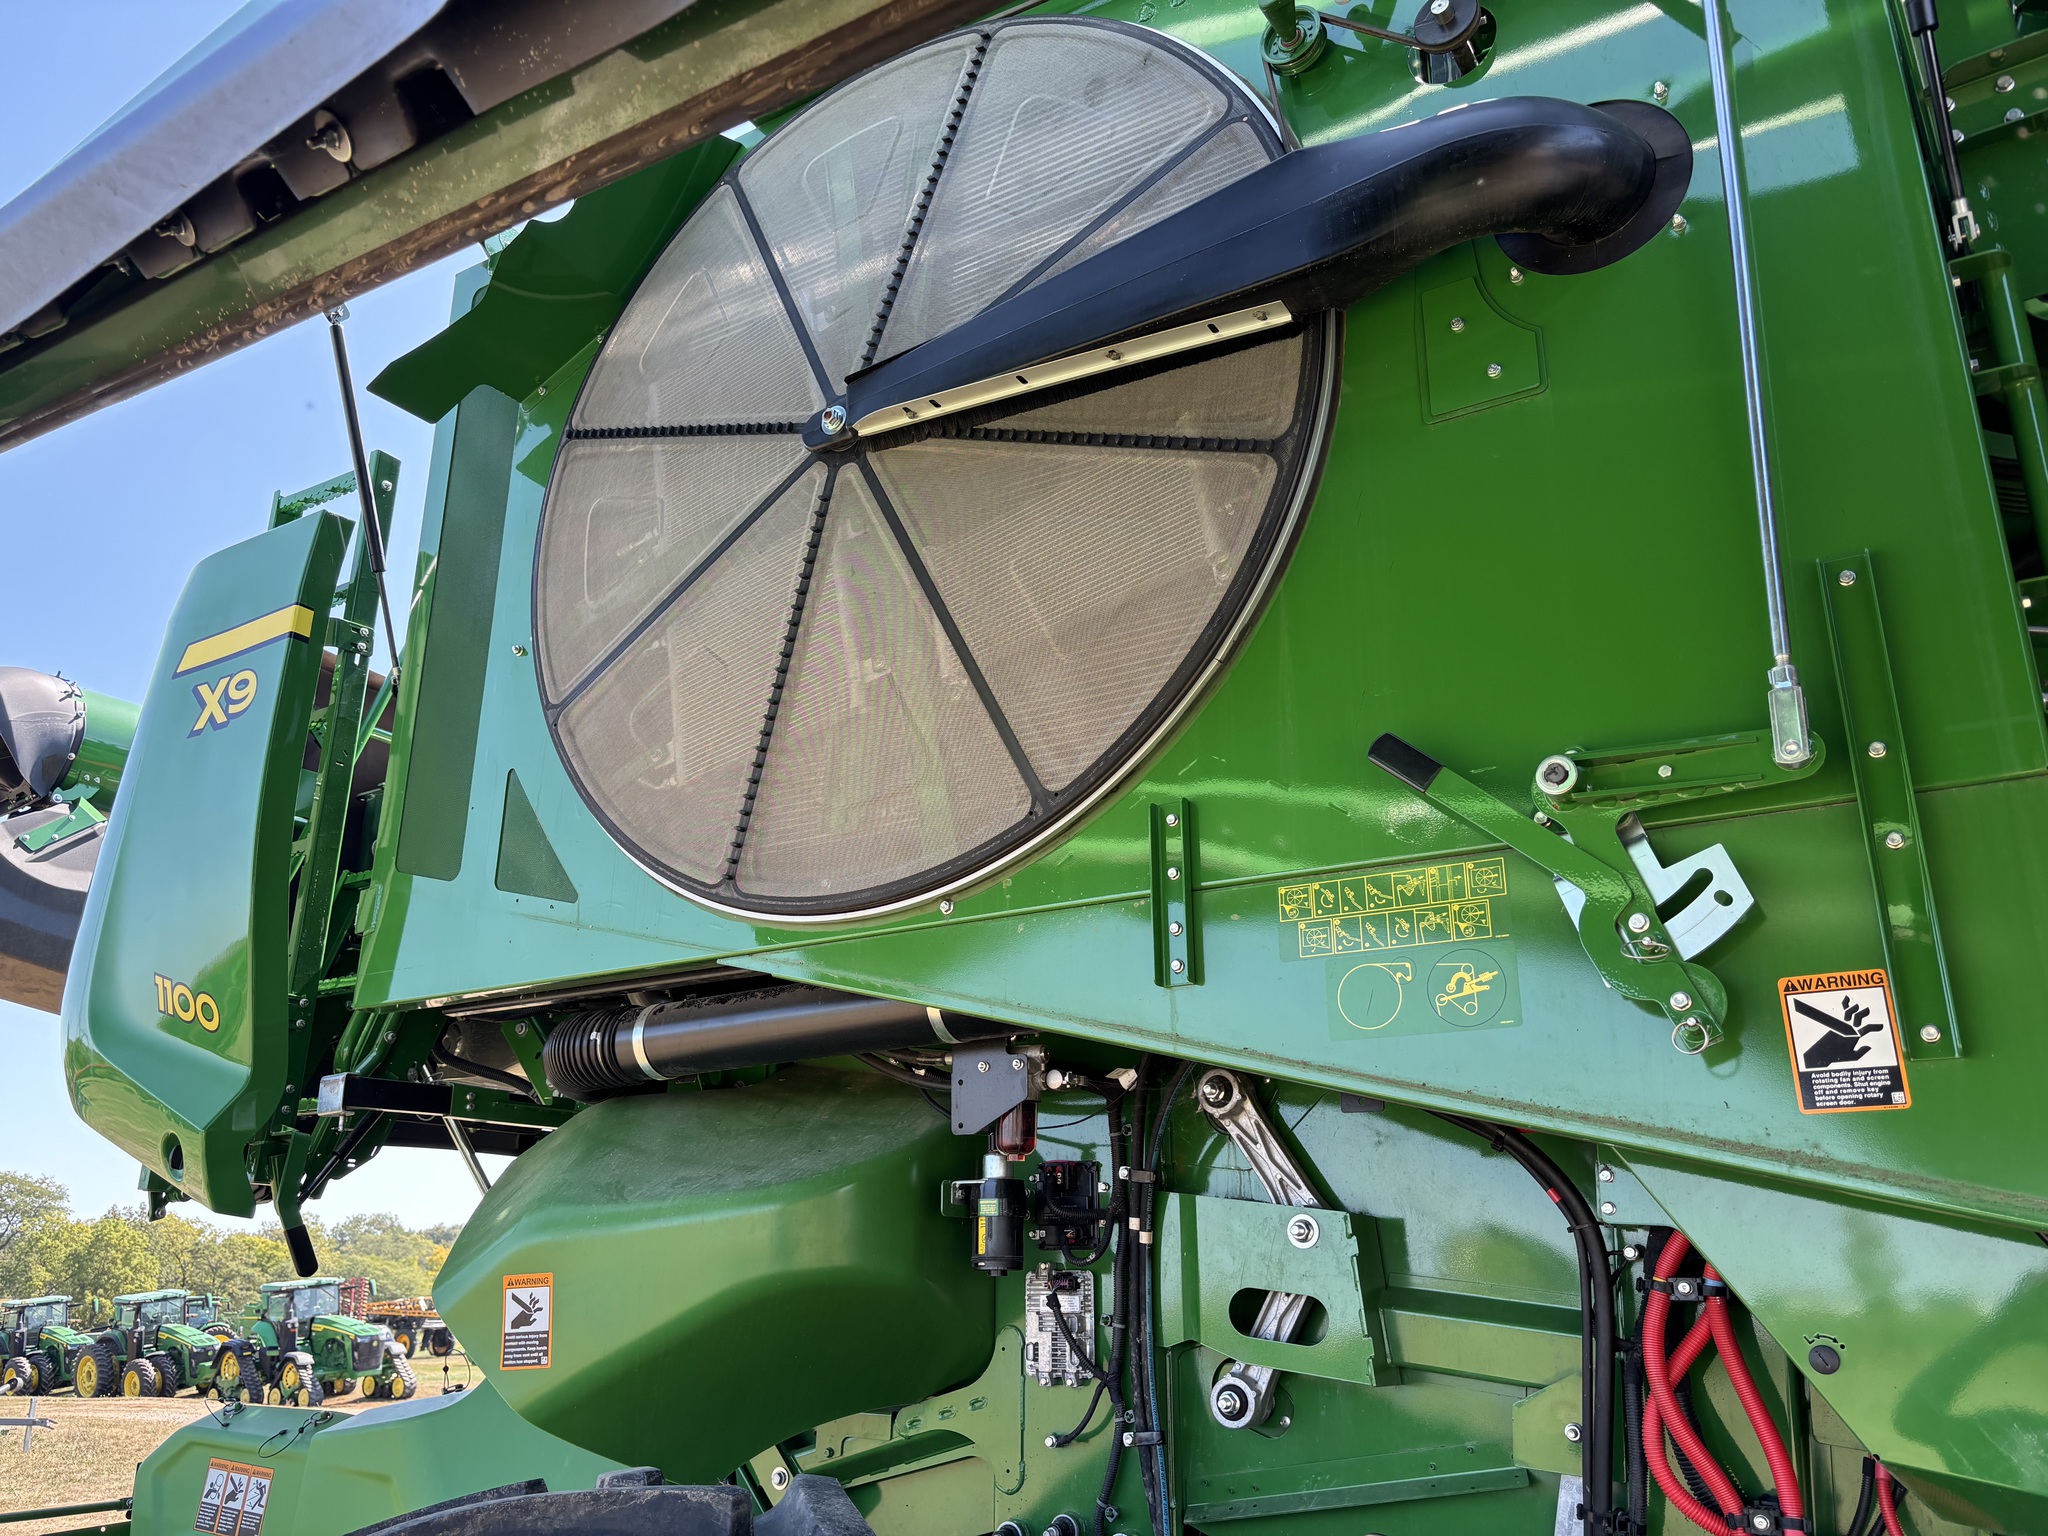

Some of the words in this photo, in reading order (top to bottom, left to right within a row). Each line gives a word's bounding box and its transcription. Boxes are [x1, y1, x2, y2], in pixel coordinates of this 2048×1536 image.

[187, 668, 259, 738] X9
[1797, 972, 1884, 991] WARNING
[153, 971, 221, 1033] 1100
[1812, 1077, 1839, 1085] rotating
[1813, 1083, 1853, 1091] components.
[514, 1277, 549, 1286] WARNING
[214, 1462, 229, 1470] WARNING
[235, 1466, 250, 1474] WARNING
